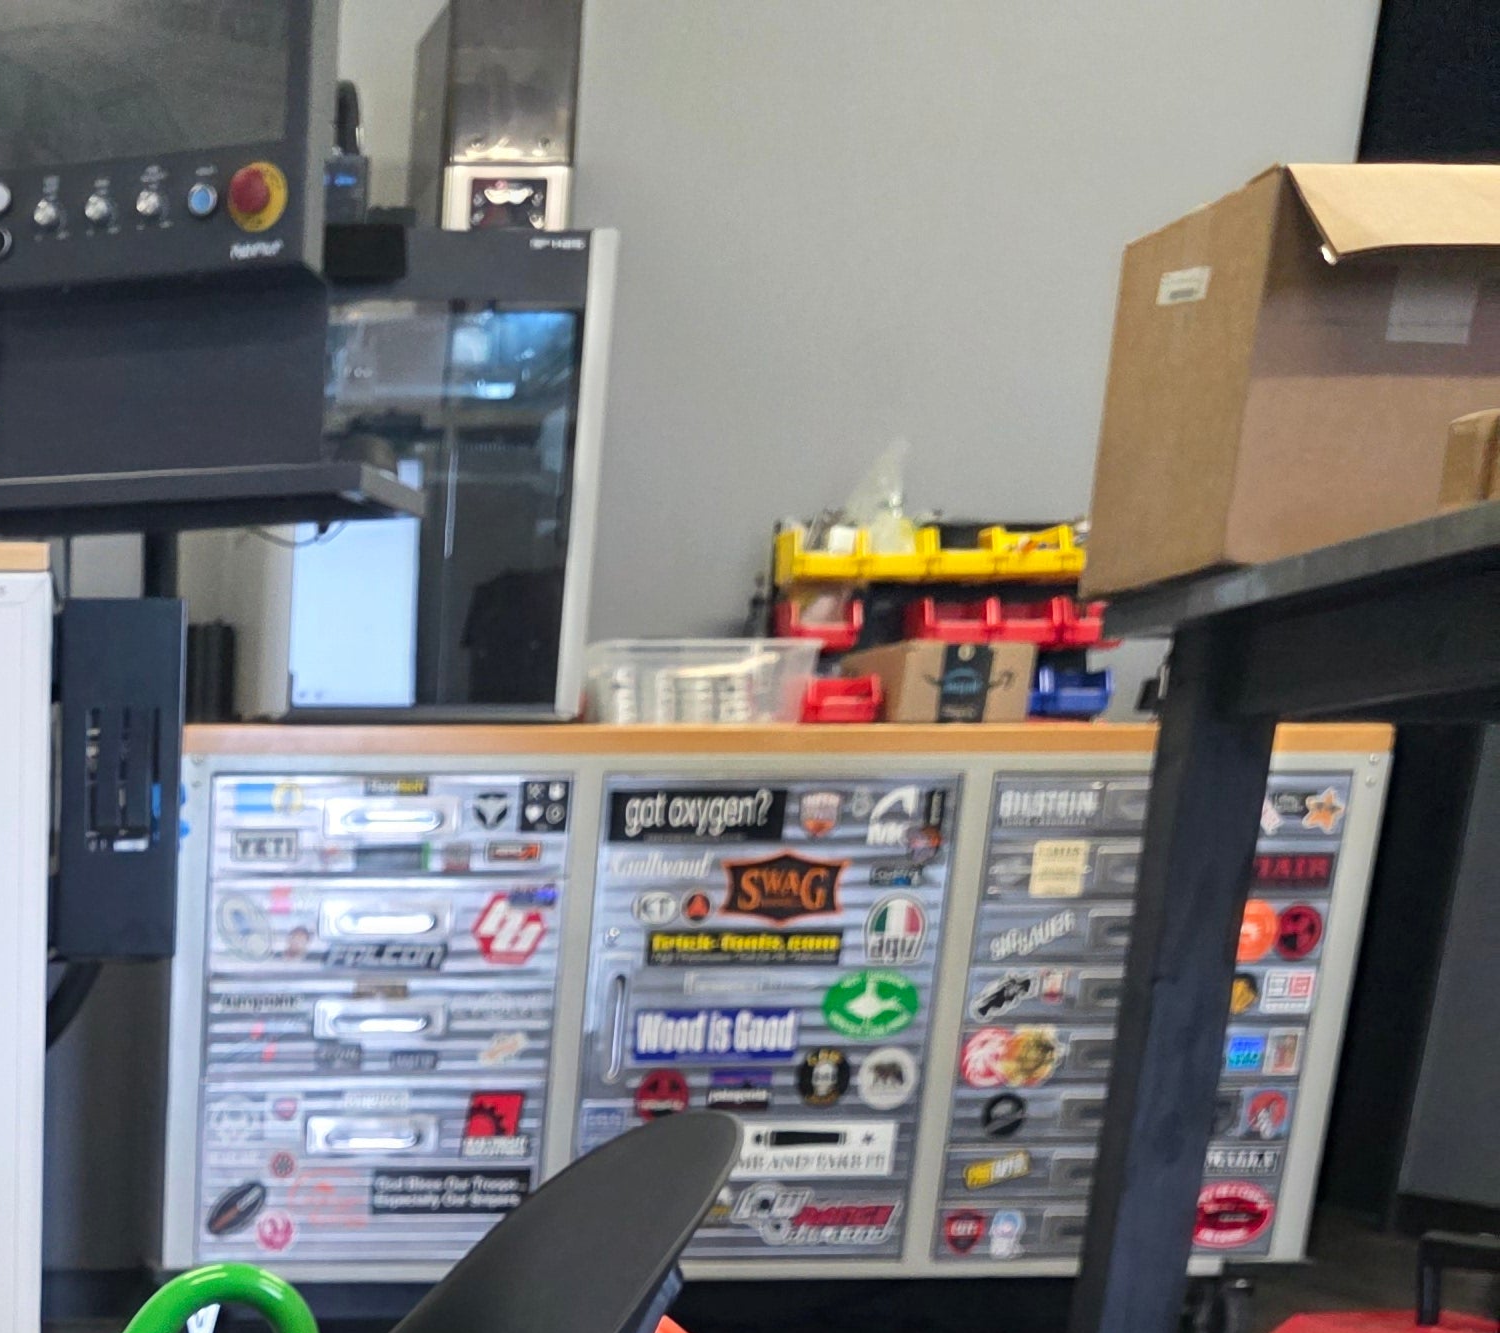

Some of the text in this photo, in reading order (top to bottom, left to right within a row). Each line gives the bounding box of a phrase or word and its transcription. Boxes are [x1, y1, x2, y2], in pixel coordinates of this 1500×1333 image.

[624, 787, 774, 838] got oxygen?
[236, 836, 297, 861] YETI
[737, 867, 830, 912] SWAG
[328, 942, 446, 969] FALCON
[636, 1011, 708, 1053] Wood
[707, 1011, 733, 1053] is
[733, 1010, 796, 1053] Good
